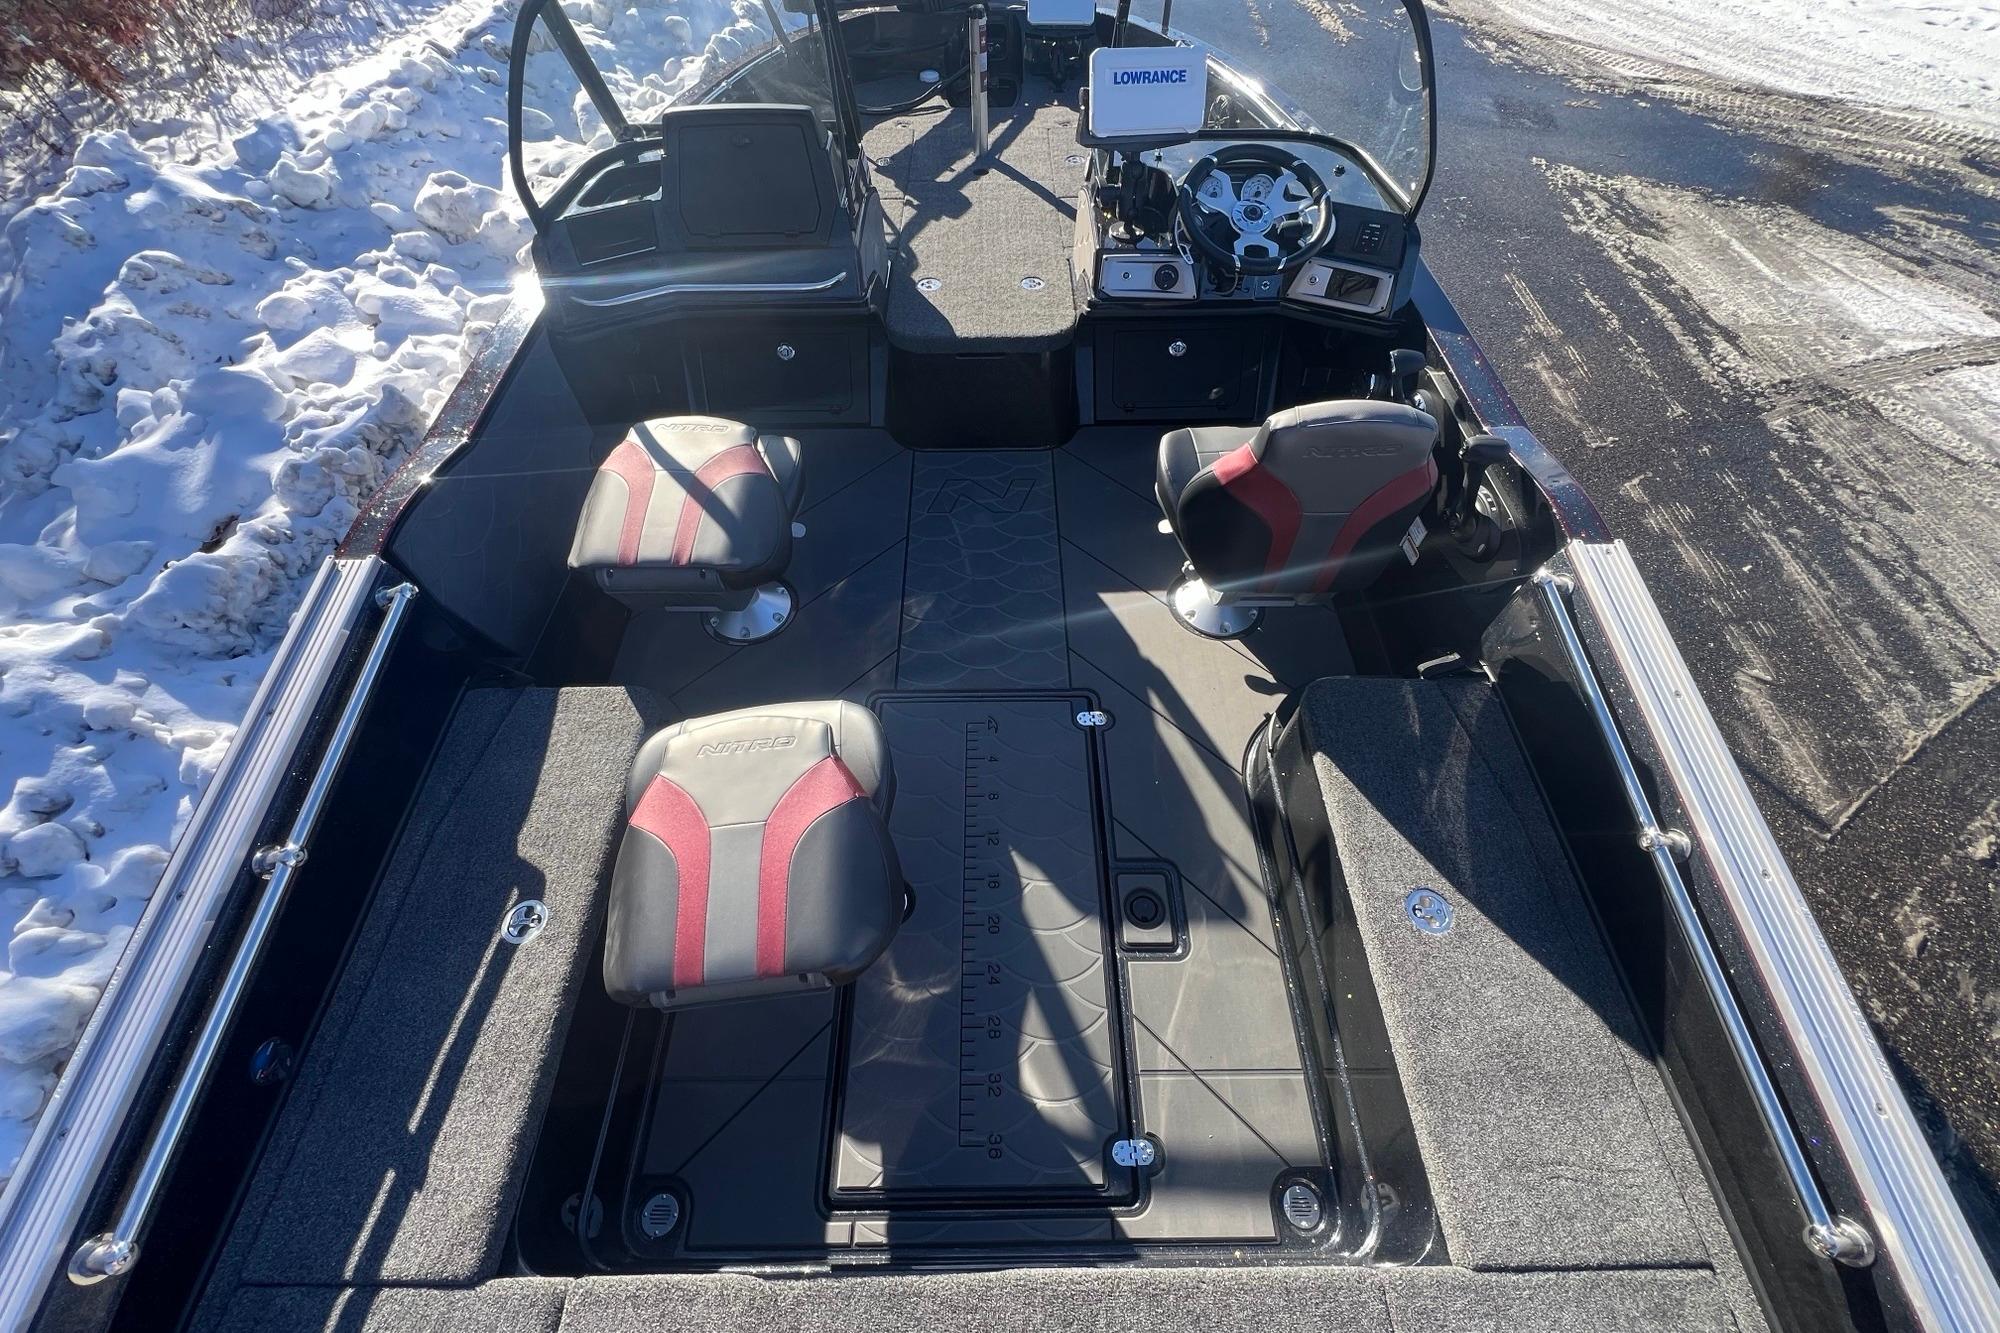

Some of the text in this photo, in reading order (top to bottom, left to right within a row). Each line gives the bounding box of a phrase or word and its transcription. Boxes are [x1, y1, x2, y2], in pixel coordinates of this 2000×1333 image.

[1113, 69, 1187, 85] LOWRANCE
[654, 422, 730, 434] NITRO
[697, 735, 798, 758] NITRO
[987, 754, 1003, 1160] 4 8 12 16 20 24 28 32 36
